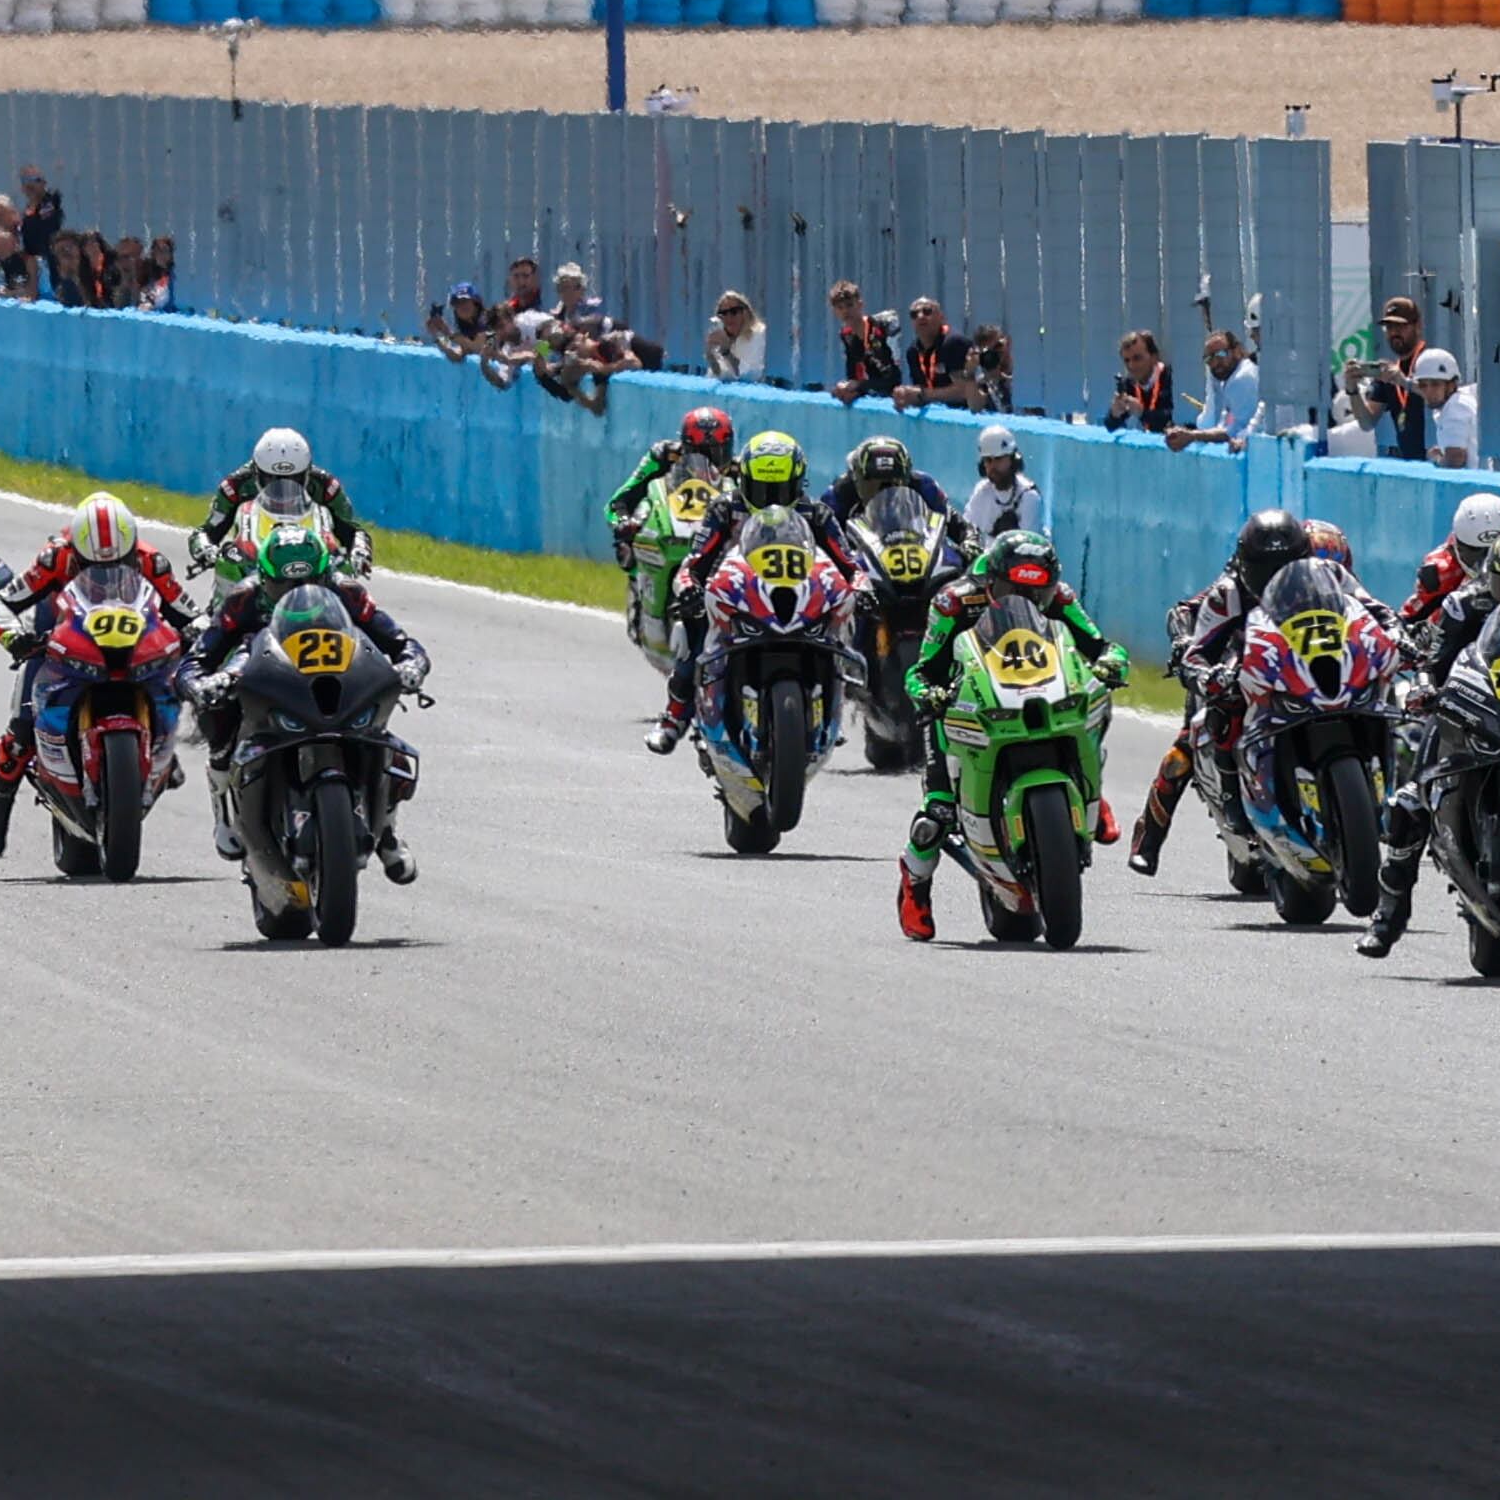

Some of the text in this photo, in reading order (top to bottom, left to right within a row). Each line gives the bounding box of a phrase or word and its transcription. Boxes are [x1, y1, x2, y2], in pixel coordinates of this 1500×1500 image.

[679, 486, 710, 513] 29
[761, 549, 807, 579] 38
[887, 547, 923, 576] 36
[93, 615, 140, 637] 96
[1291, 614, 1343, 656] 75
[297, 632, 344, 668] 23
[1001, 640, 1048, 669] 40
